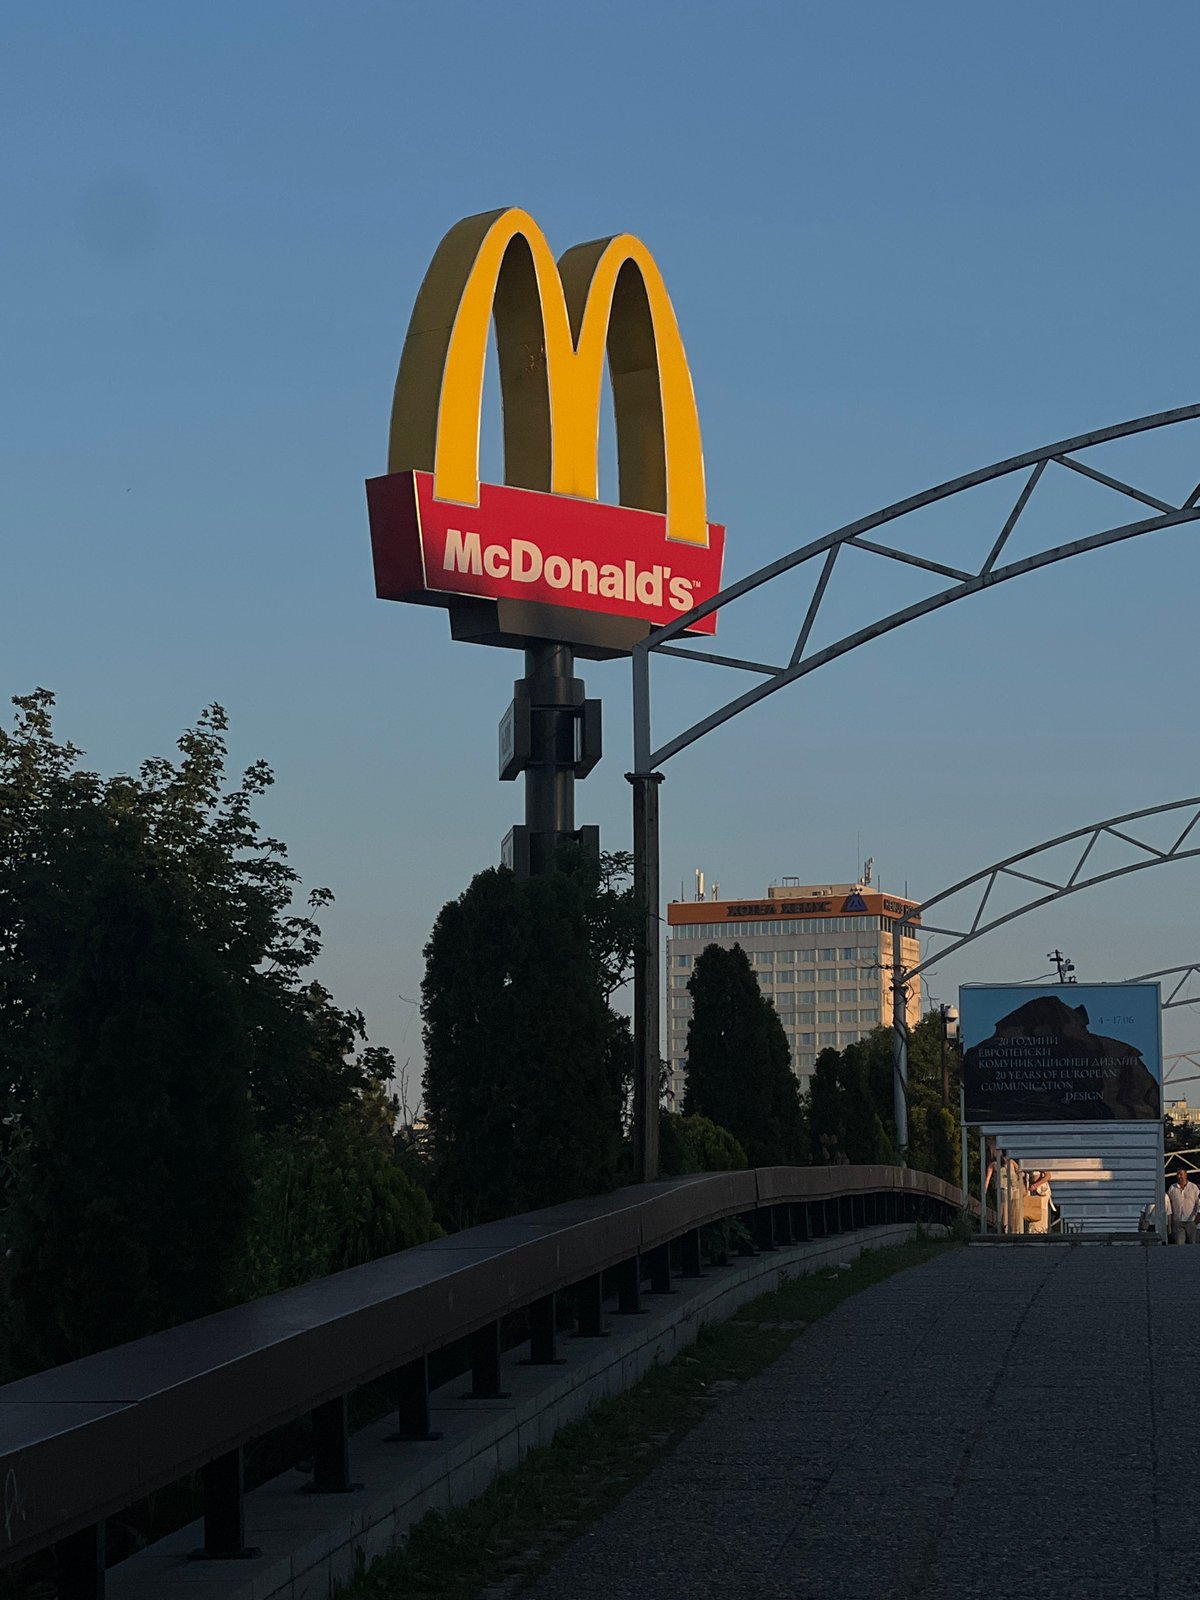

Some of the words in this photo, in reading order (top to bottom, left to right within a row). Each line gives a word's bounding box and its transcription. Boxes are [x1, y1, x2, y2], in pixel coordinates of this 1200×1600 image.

[1113, 1015, 1135, 1025] 17.06
[1011, 1035, 1058, 1046] ГОДИНИ
[978, 1057, 1089, 1069] КОМУНИКАЦИОНЕН
[995, 1071, 1007, 1081] 20
[1008, 1070, 1042, 1080] YEARS
[1043, 1070, 1058, 1079] OF
[1060, 1069, 1119, 1079] EUROPEAN
[980, 1081, 1074, 1091] COMMUNICATION
[1065, 1091, 1104, 1102] DESIGN
